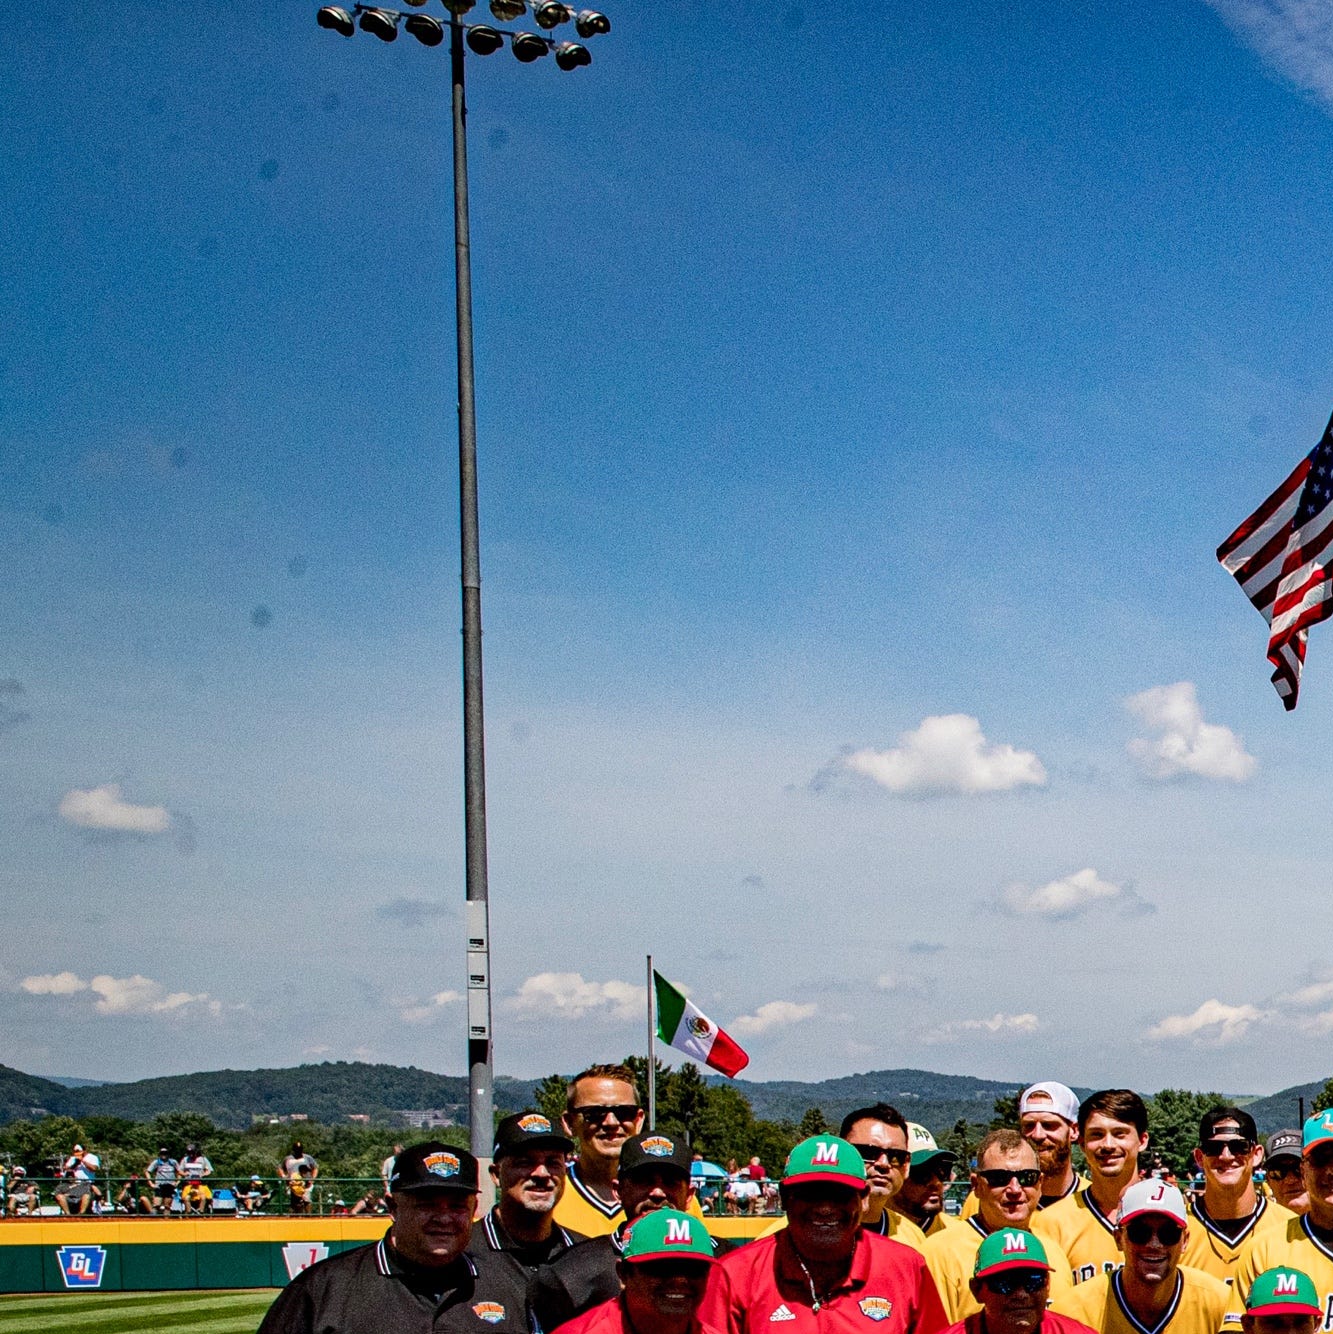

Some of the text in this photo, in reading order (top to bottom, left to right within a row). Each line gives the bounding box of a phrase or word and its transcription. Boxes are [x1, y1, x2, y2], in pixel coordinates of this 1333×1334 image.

[815, 1142, 840, 1164] M
[1151, 1185, 1165, 1202] J
[667, 1219, 692, 1242] M
[1003, 1232, 1028, 1253] M
[70, 1252, 95, 1277] GL
[1277, 1274, 1298, 1292] M
